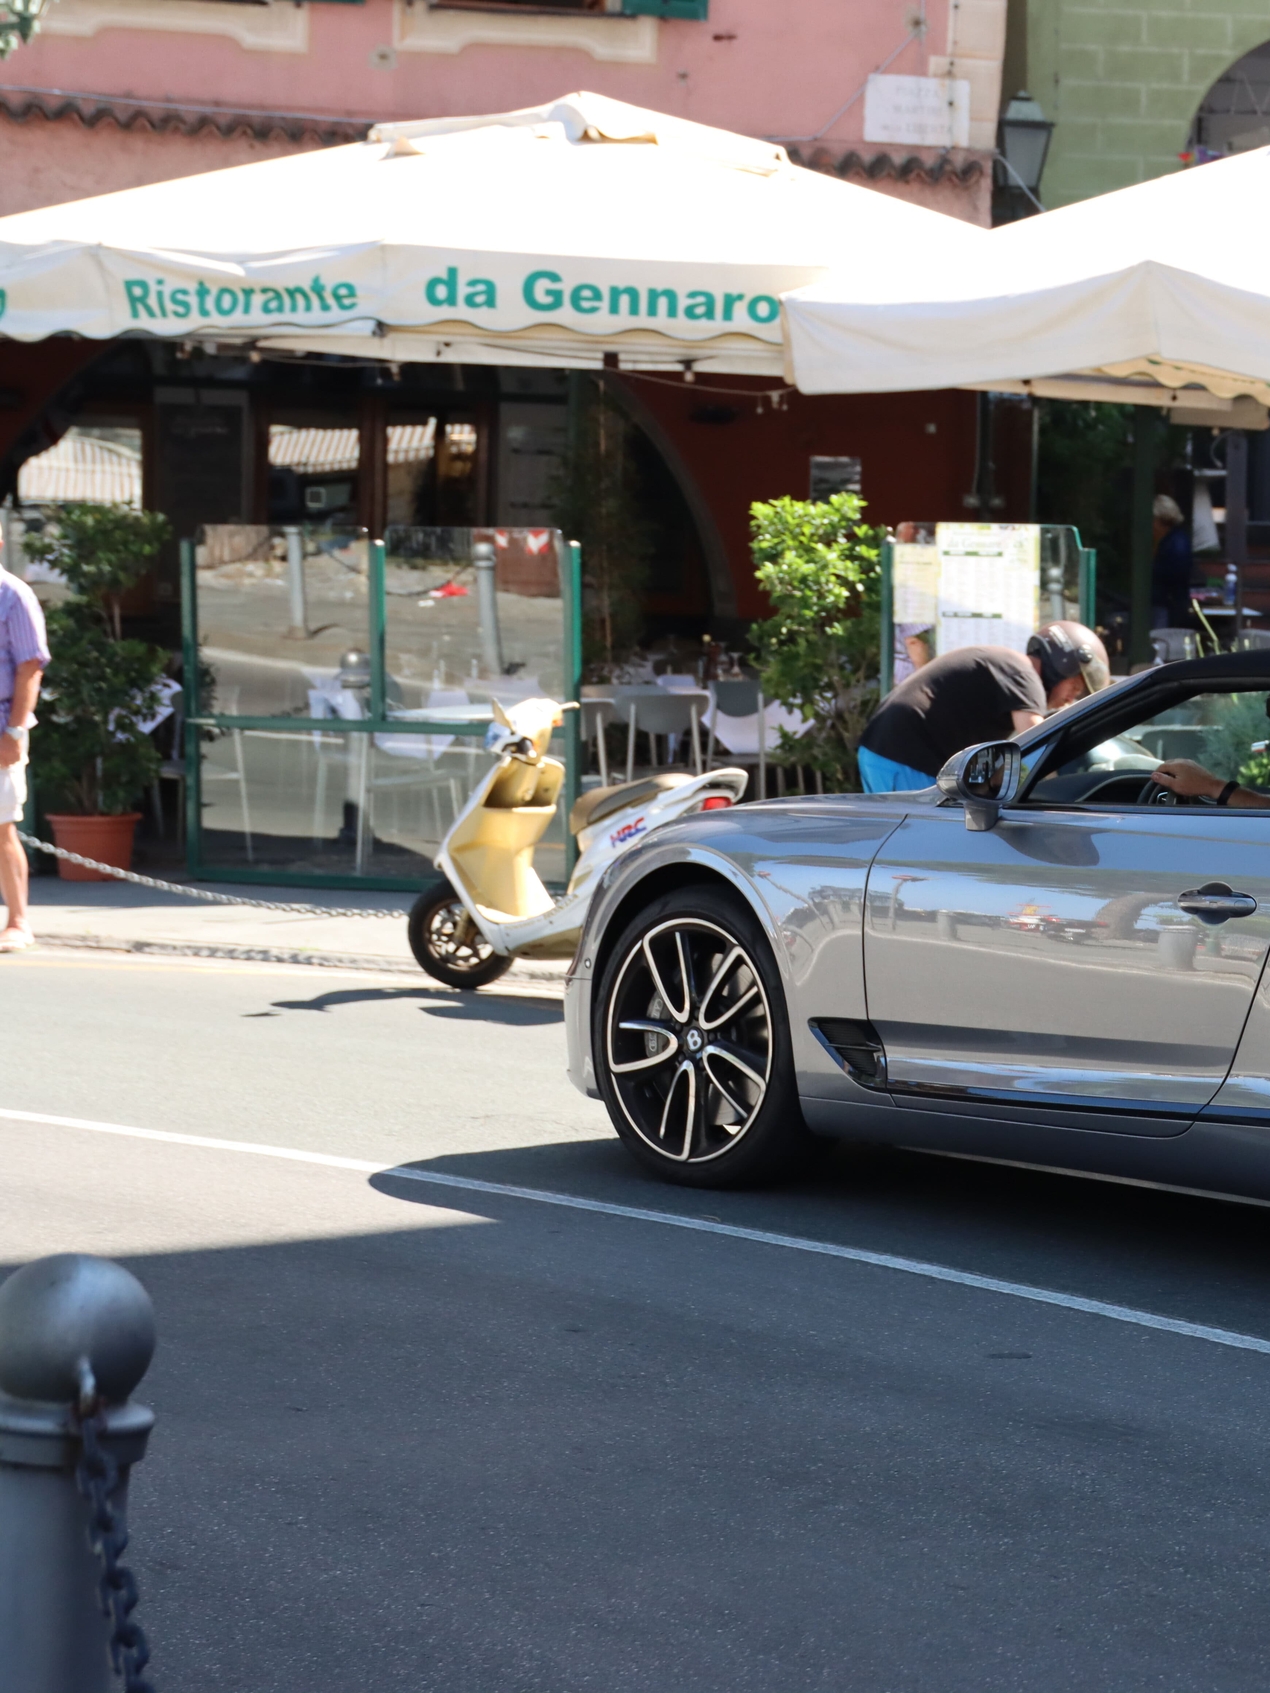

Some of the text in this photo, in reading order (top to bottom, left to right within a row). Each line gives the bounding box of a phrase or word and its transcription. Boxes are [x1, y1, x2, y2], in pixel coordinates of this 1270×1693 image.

[124, 267, 781, 326] Ristorante da Gennaro
[609, 817, 647, 849] HRC
